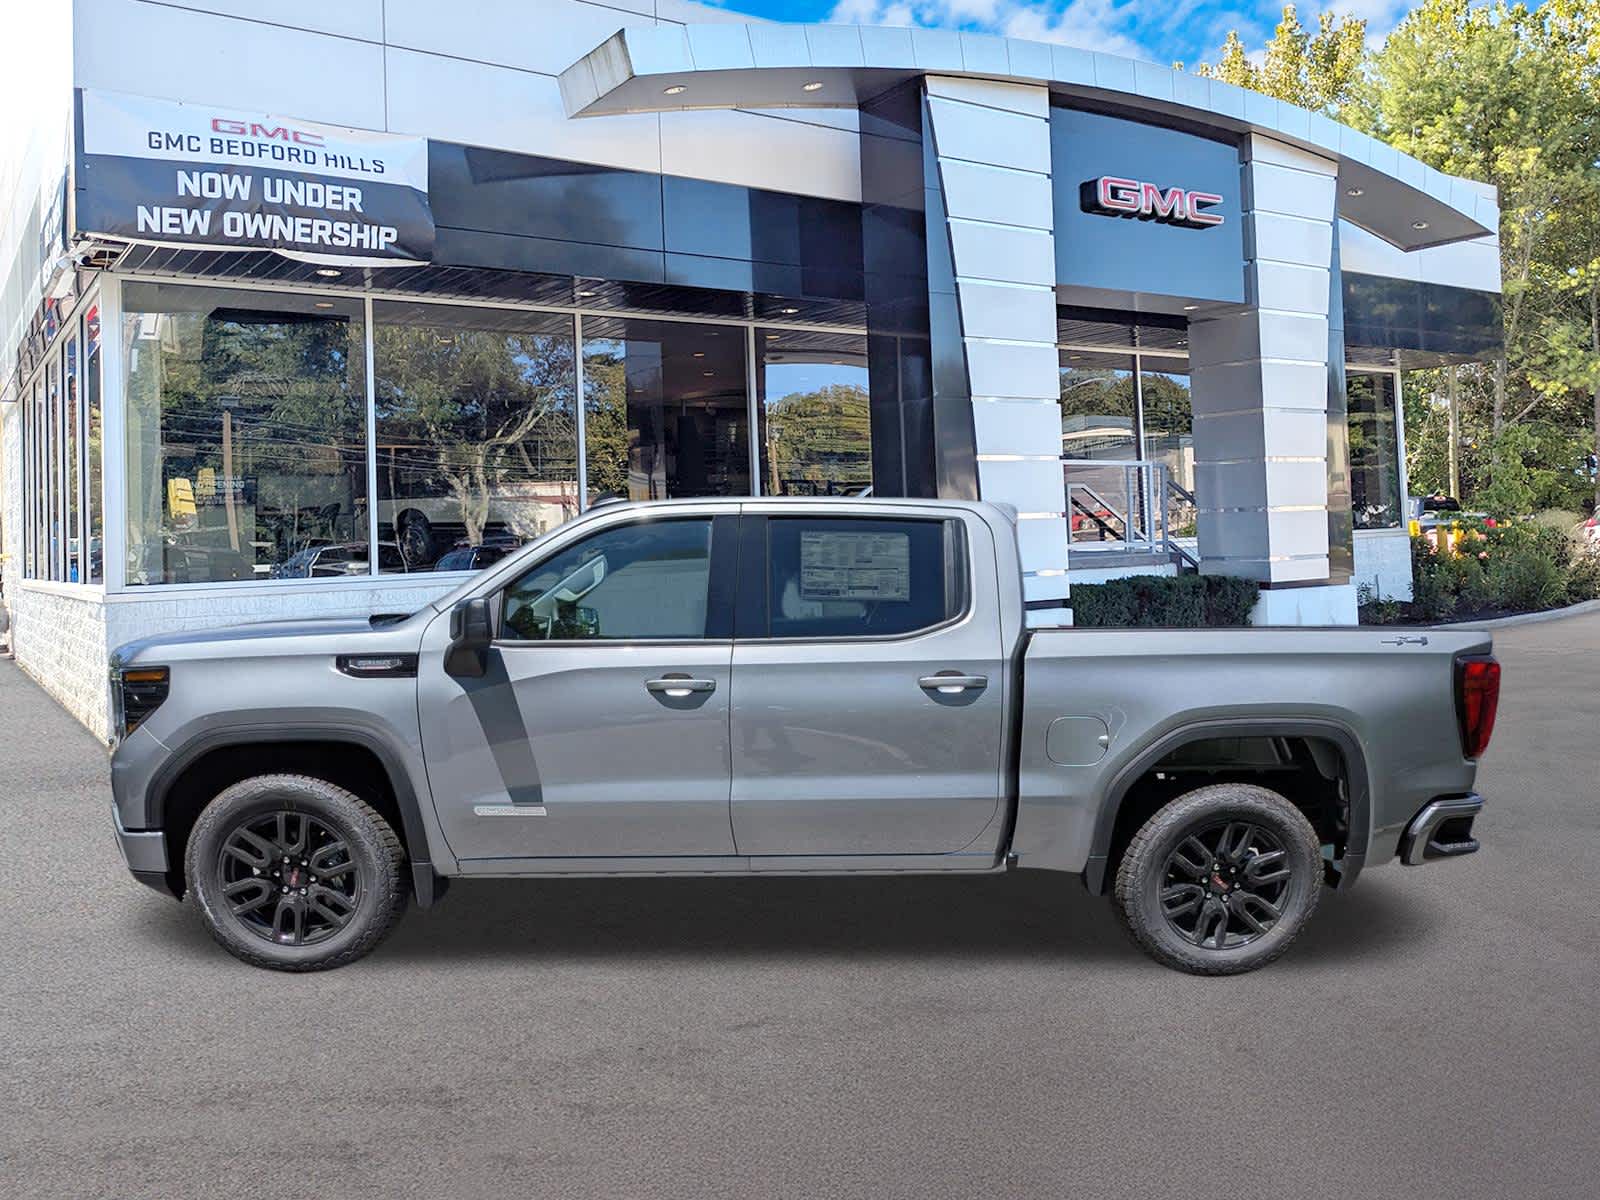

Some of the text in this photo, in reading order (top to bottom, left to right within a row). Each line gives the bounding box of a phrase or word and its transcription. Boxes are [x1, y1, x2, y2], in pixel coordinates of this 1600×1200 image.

[148, 131, 385, 174] GMC BEDFORD HILLS
[211, 118, 326, 148] GMC
[177, 170, 364, 213] NOW UNDER
[1097, 175, 1225, 225] GMC
[136, 205, 398, 250] NEW OWNERSHIP
